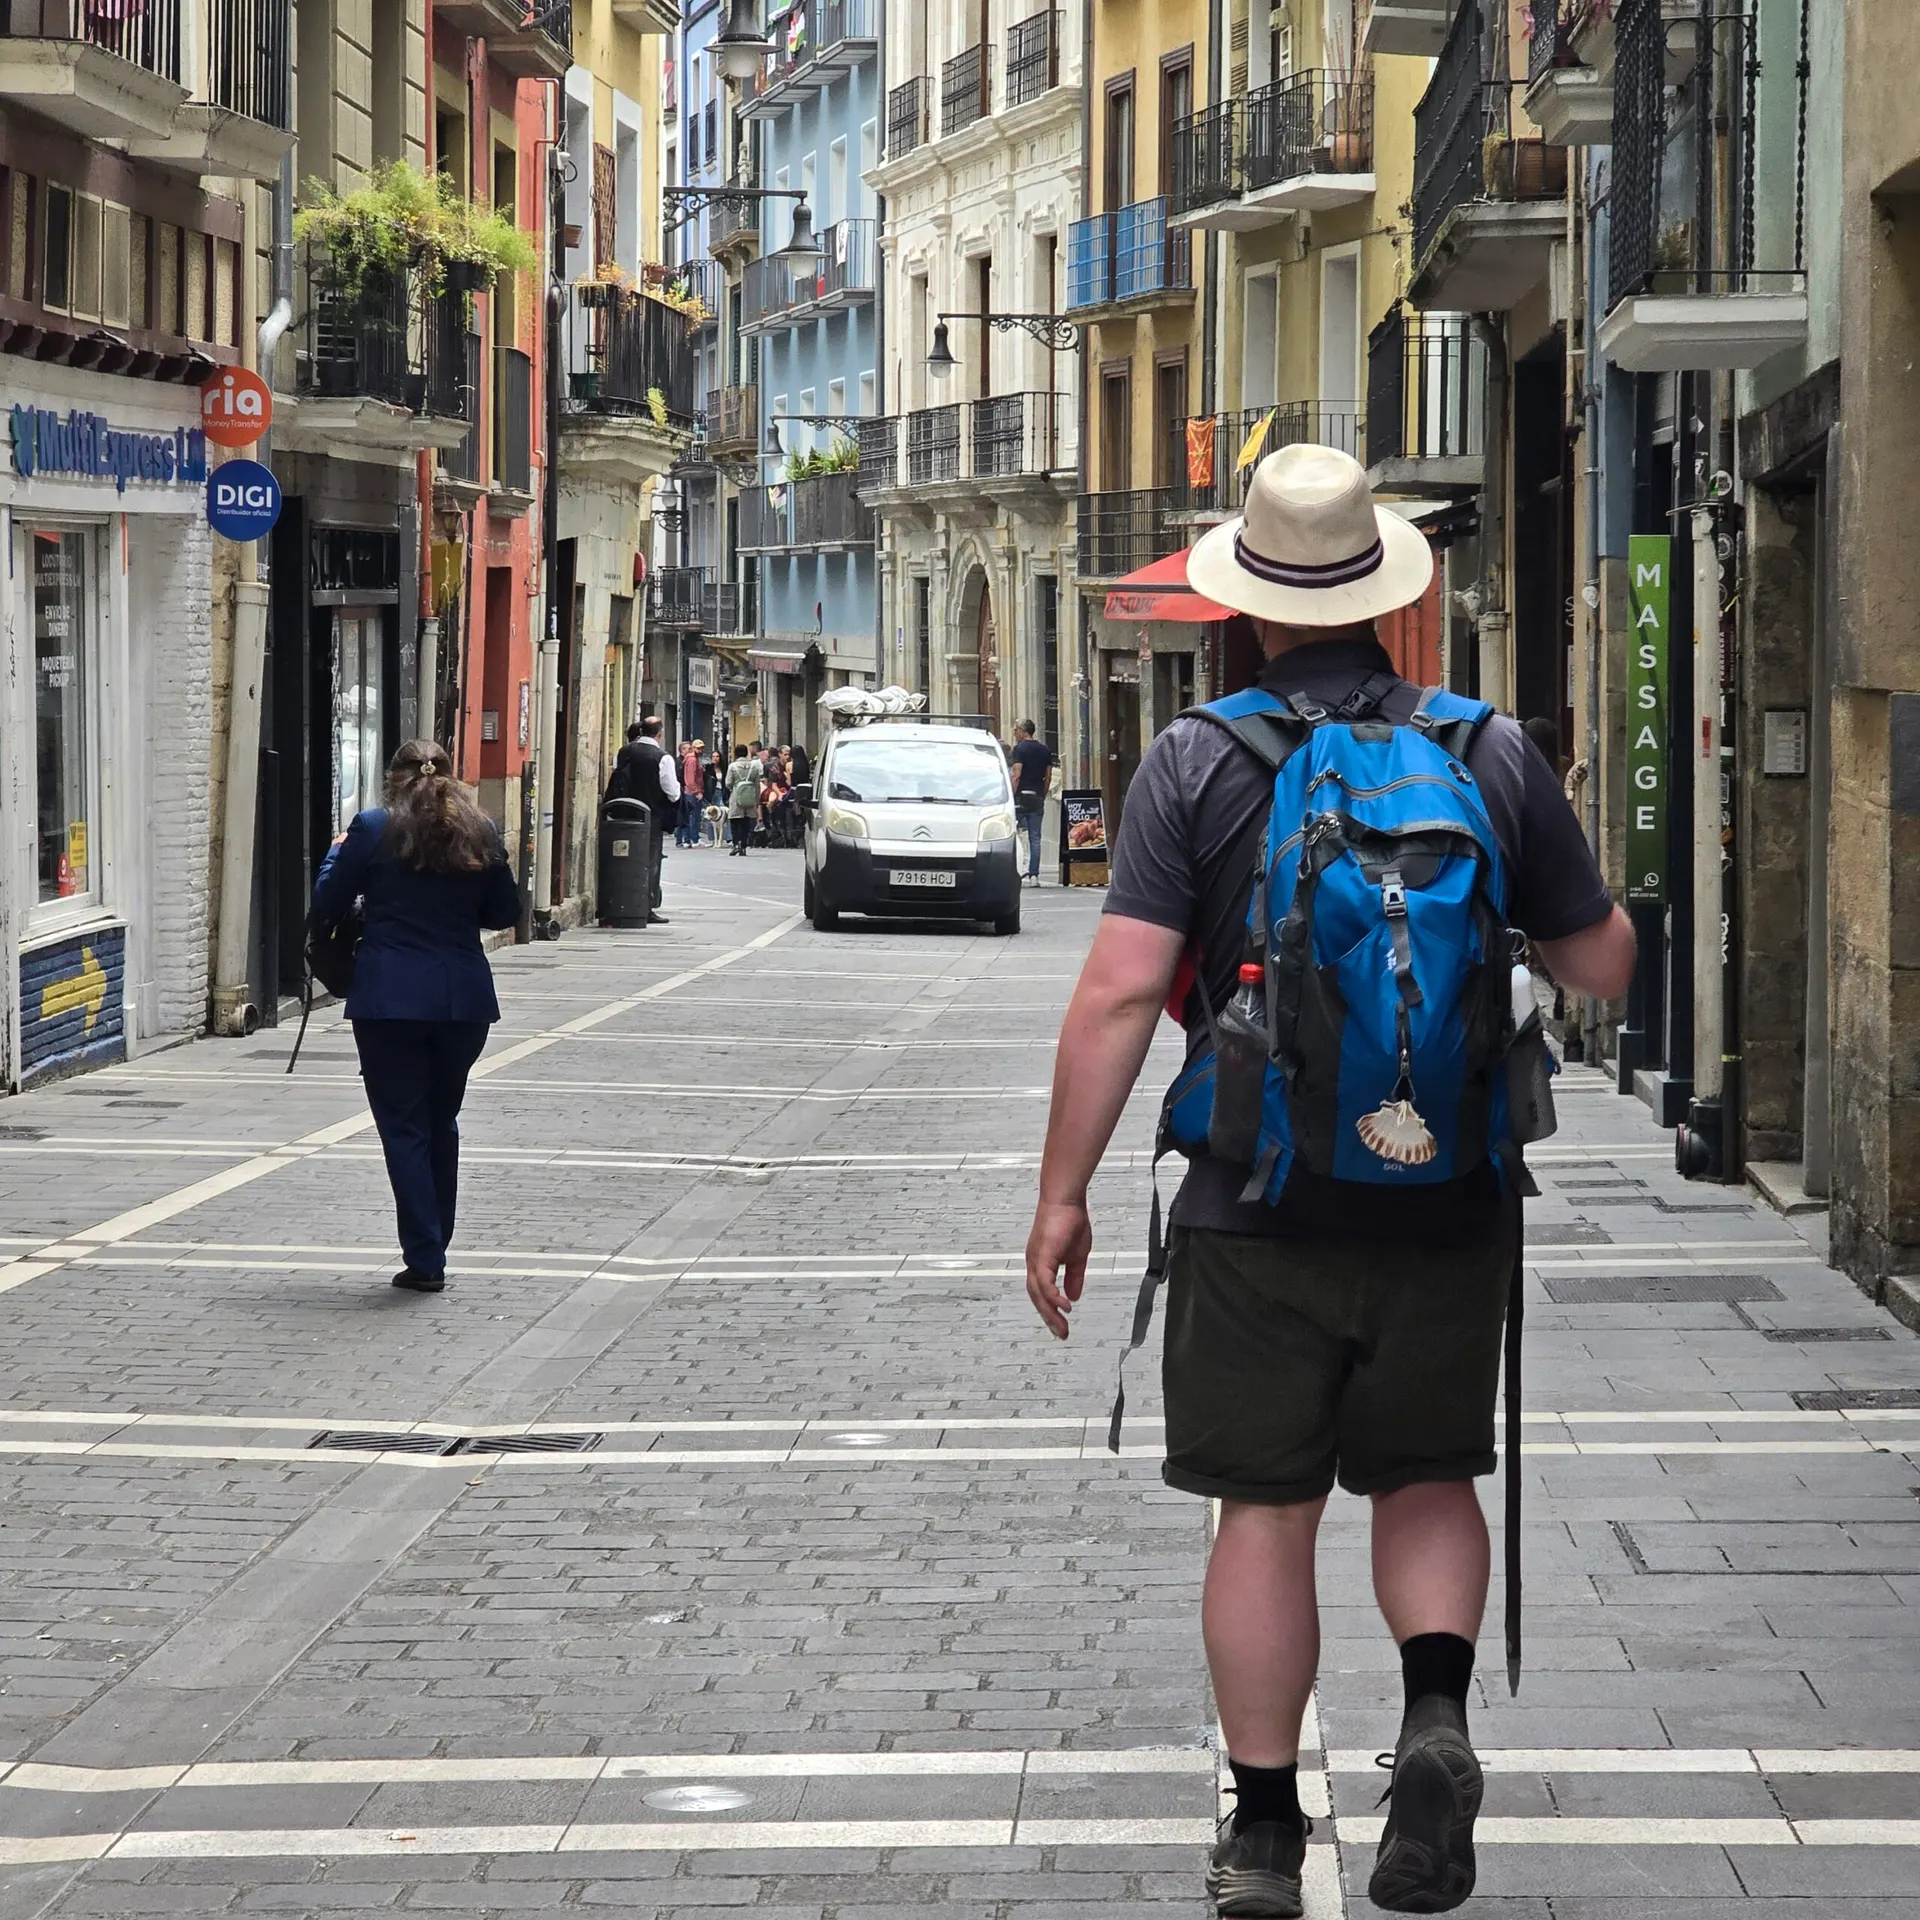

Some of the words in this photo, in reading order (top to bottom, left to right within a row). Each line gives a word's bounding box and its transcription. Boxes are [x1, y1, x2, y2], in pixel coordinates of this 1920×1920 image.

[203, 375, 263, 416] ria
[203, 418, 230, 429] Money
[230, 418, 264, 429] Transfer
[37, 408, 174, 493] MultiExpress
[217, 485, 273, 508] DIGI
[216, 507, 251, 517] Distribuidor
[252, 509, 272, 517] oficial
[1634, 563, 1662, 830] MASSAGE
[897, 872, 927, 884] 7916
[930, 873, 953, 885] HCJ
